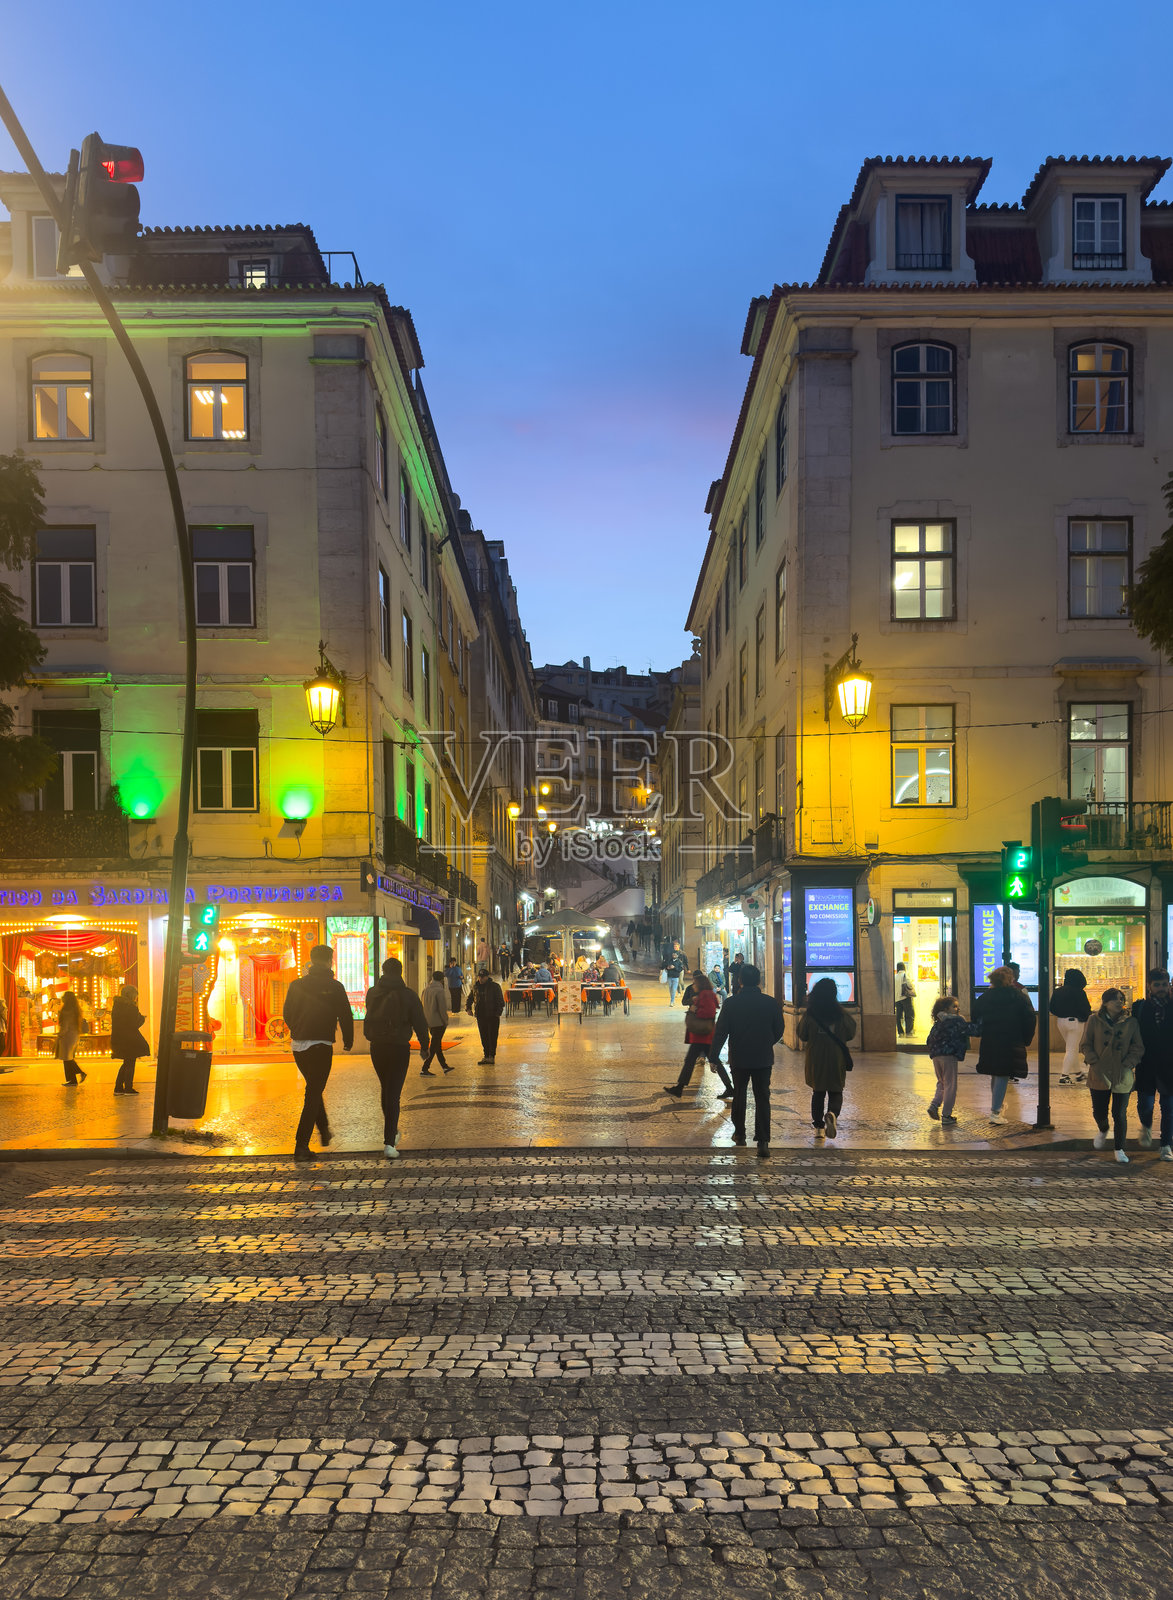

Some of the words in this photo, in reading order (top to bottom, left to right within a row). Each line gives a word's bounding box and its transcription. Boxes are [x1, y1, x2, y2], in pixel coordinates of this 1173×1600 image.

[1017, 852, 1026, 868] 2
[52, 890, 78, 905] DA
[88, 886, 195, 906] SARDINA
[202, 907, 214, 924] 2
[982, 909, 995, 983] EXCHANGE
